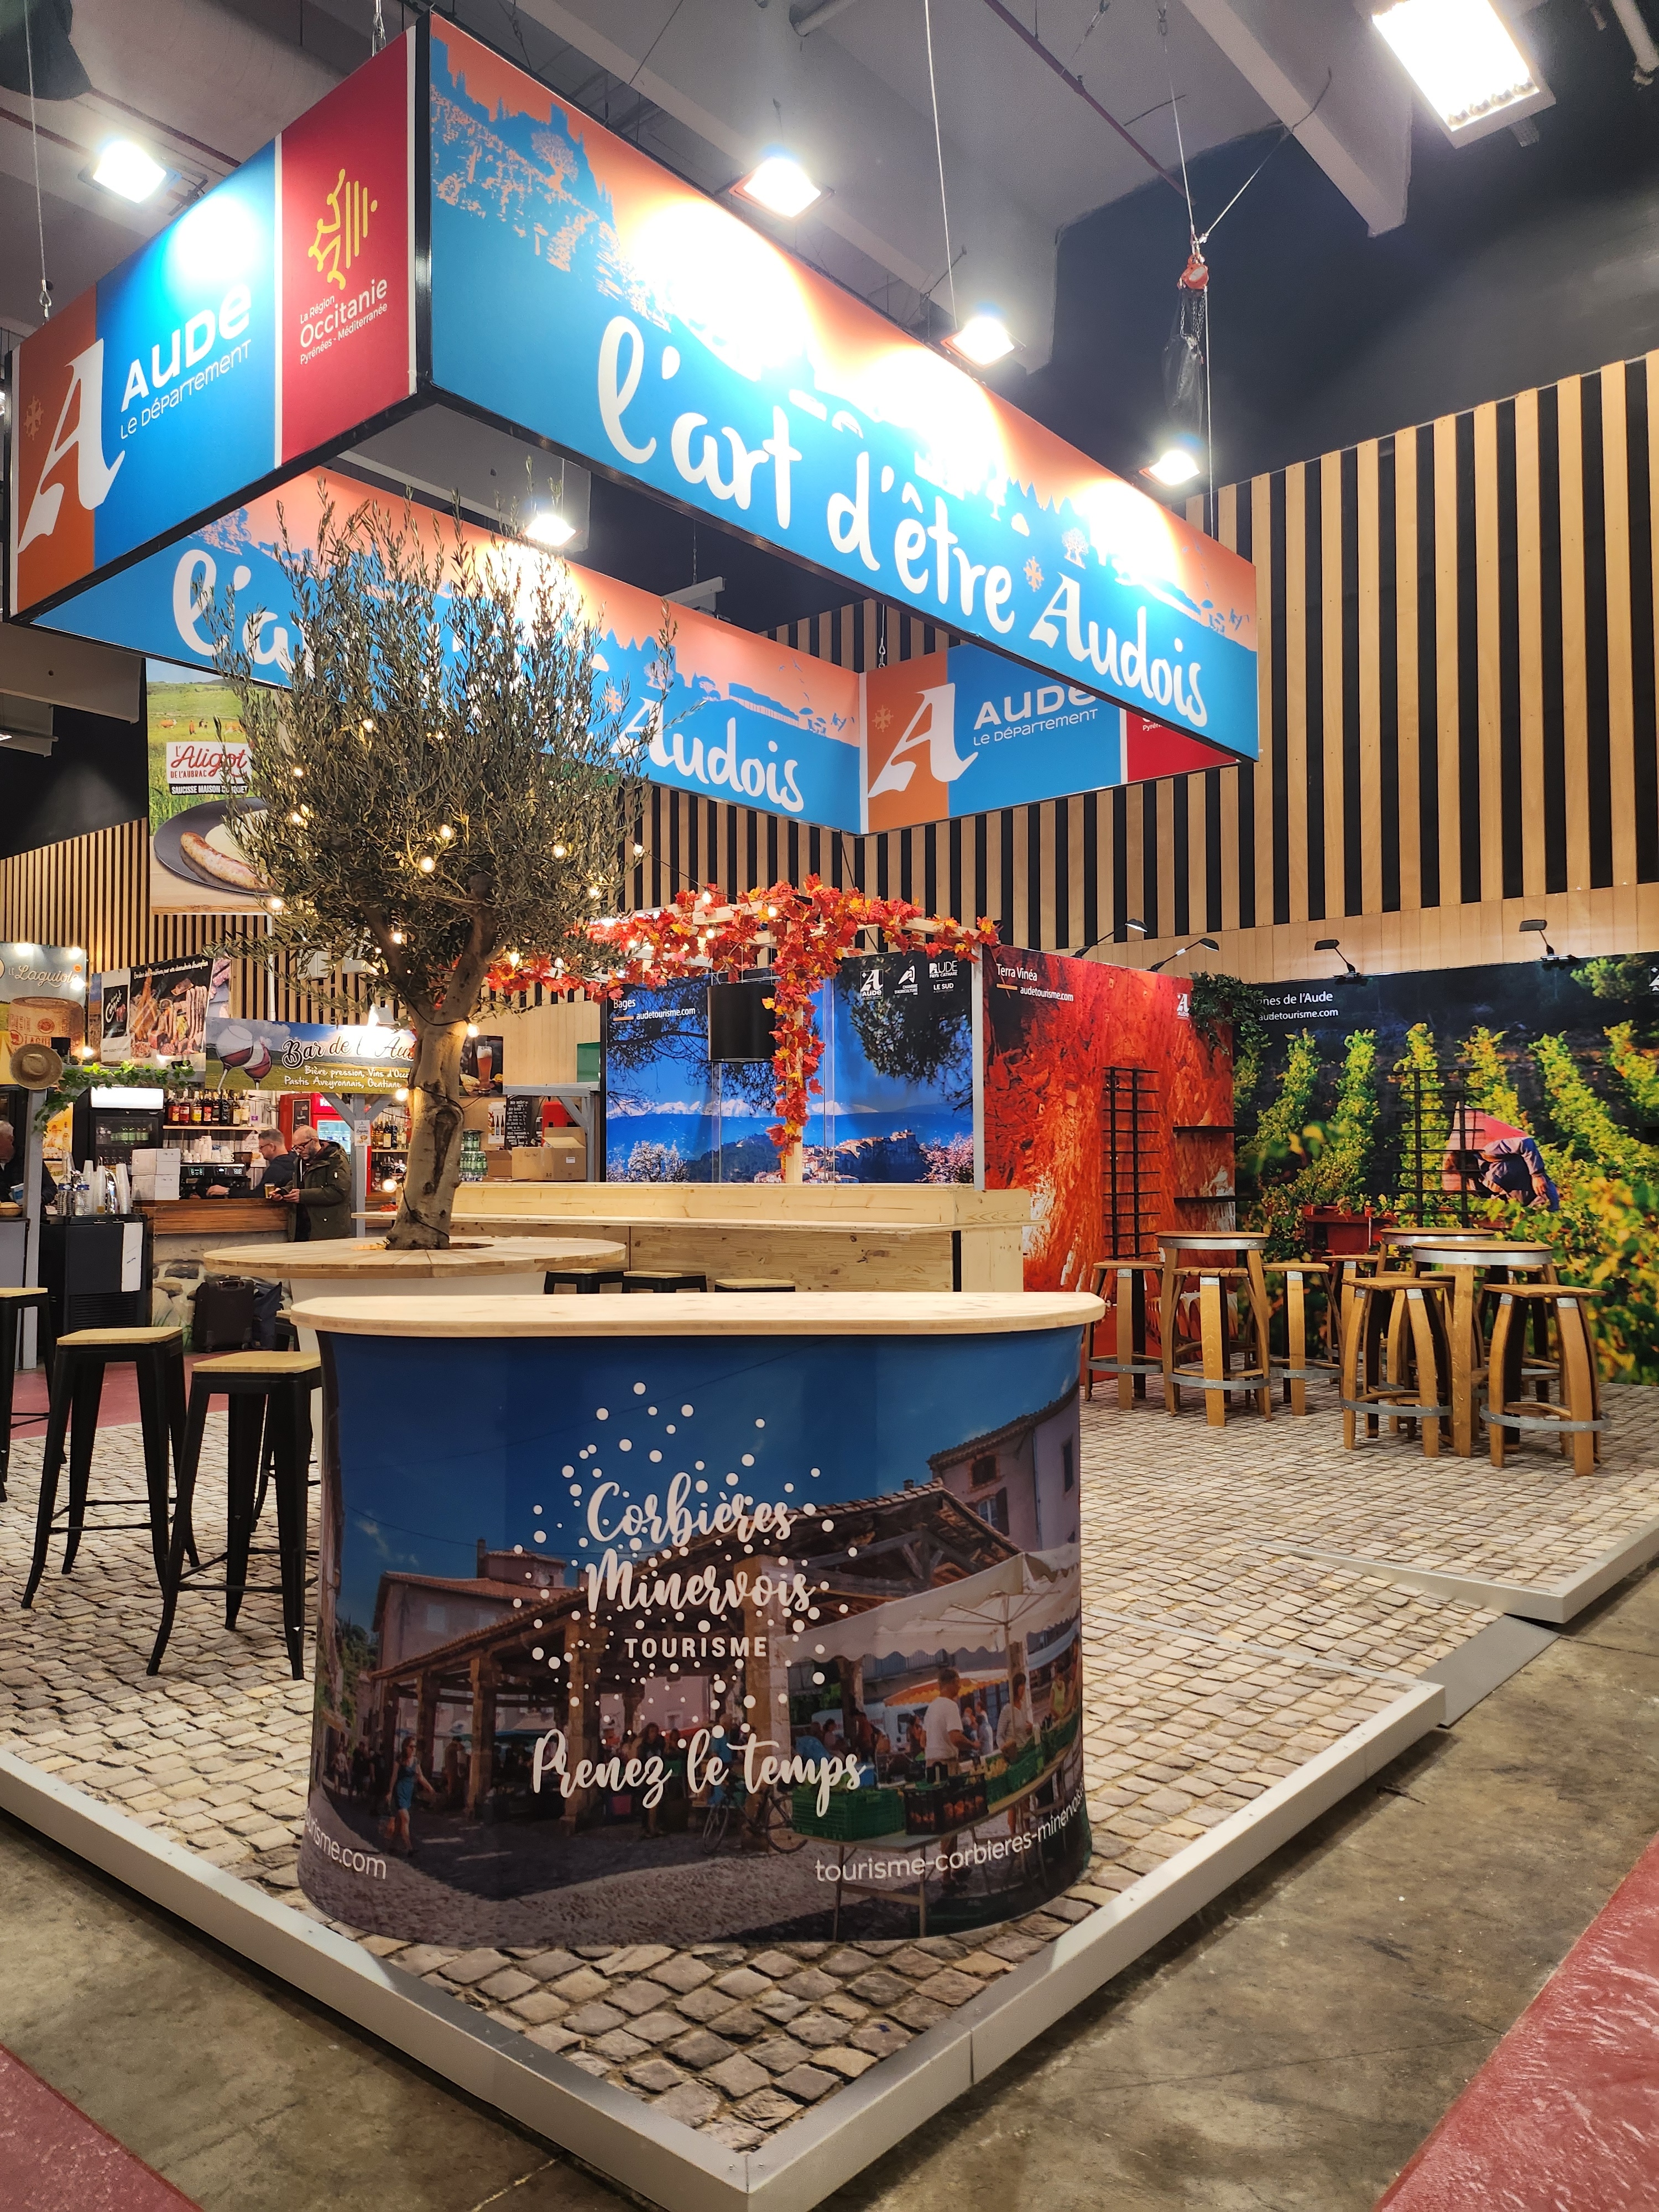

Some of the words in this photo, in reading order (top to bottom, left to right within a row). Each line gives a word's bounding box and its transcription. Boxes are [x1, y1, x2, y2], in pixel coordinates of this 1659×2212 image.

[300, 312, 309, 325] La
[310, 295, 335, 318] Région
[300, 278, 387, 348] Occitanie
[300, 338, 332, 365] Pyrénées
[338, 303, 388, 341] Méditerranée
[598, 315, 801, 530] l'art
[826, 450, 1015, 635] d'être
[1029, 572, 1209, 728] Audois
[179, 770, 207, 779] L'AUBRAC
[171, 785, 198, 795] SAUCISSE
[198, 785, 221, 794] MAISON
[996, 963, 1016, 978] Terra
[1016, 966, 1038, 982] Vinéa
[1020, 986, 1074, 1002] audetourisme.com
[1283, 993, 1297, 1005] de
[1299, 990, 1333, 1004] l'Aude
[613, 999, 636, 1011] Bages
[636, 1007, 696, 1021] audetourisme.com
[1258, 1008, 1339, 1022] audetourisme.com
[282, 1039, 326, 1070] Bar
[328, 1035, 351, 1056] de
[304, 1065, 328, 1076] Bière
[330, 1070, 366, 1079] pression,
[367, 1068, 384, 1078] Vins
[284, 1075, 310, 1086] Pastis
[312, 1078, 365, 1089] Aveyronnais,
[367, 1078, 402, 1089] Gentiane
[587, 1471, 797, 1548] Corbières
[586, 1548, 816, 1617] Minervois
[624, 1636, 769, 1658] TOURISME
[532, 1728, 673, 1809] Prenez
[686, 1728, 729, 1794] le
[727, 1733, 867, 1817] temps
